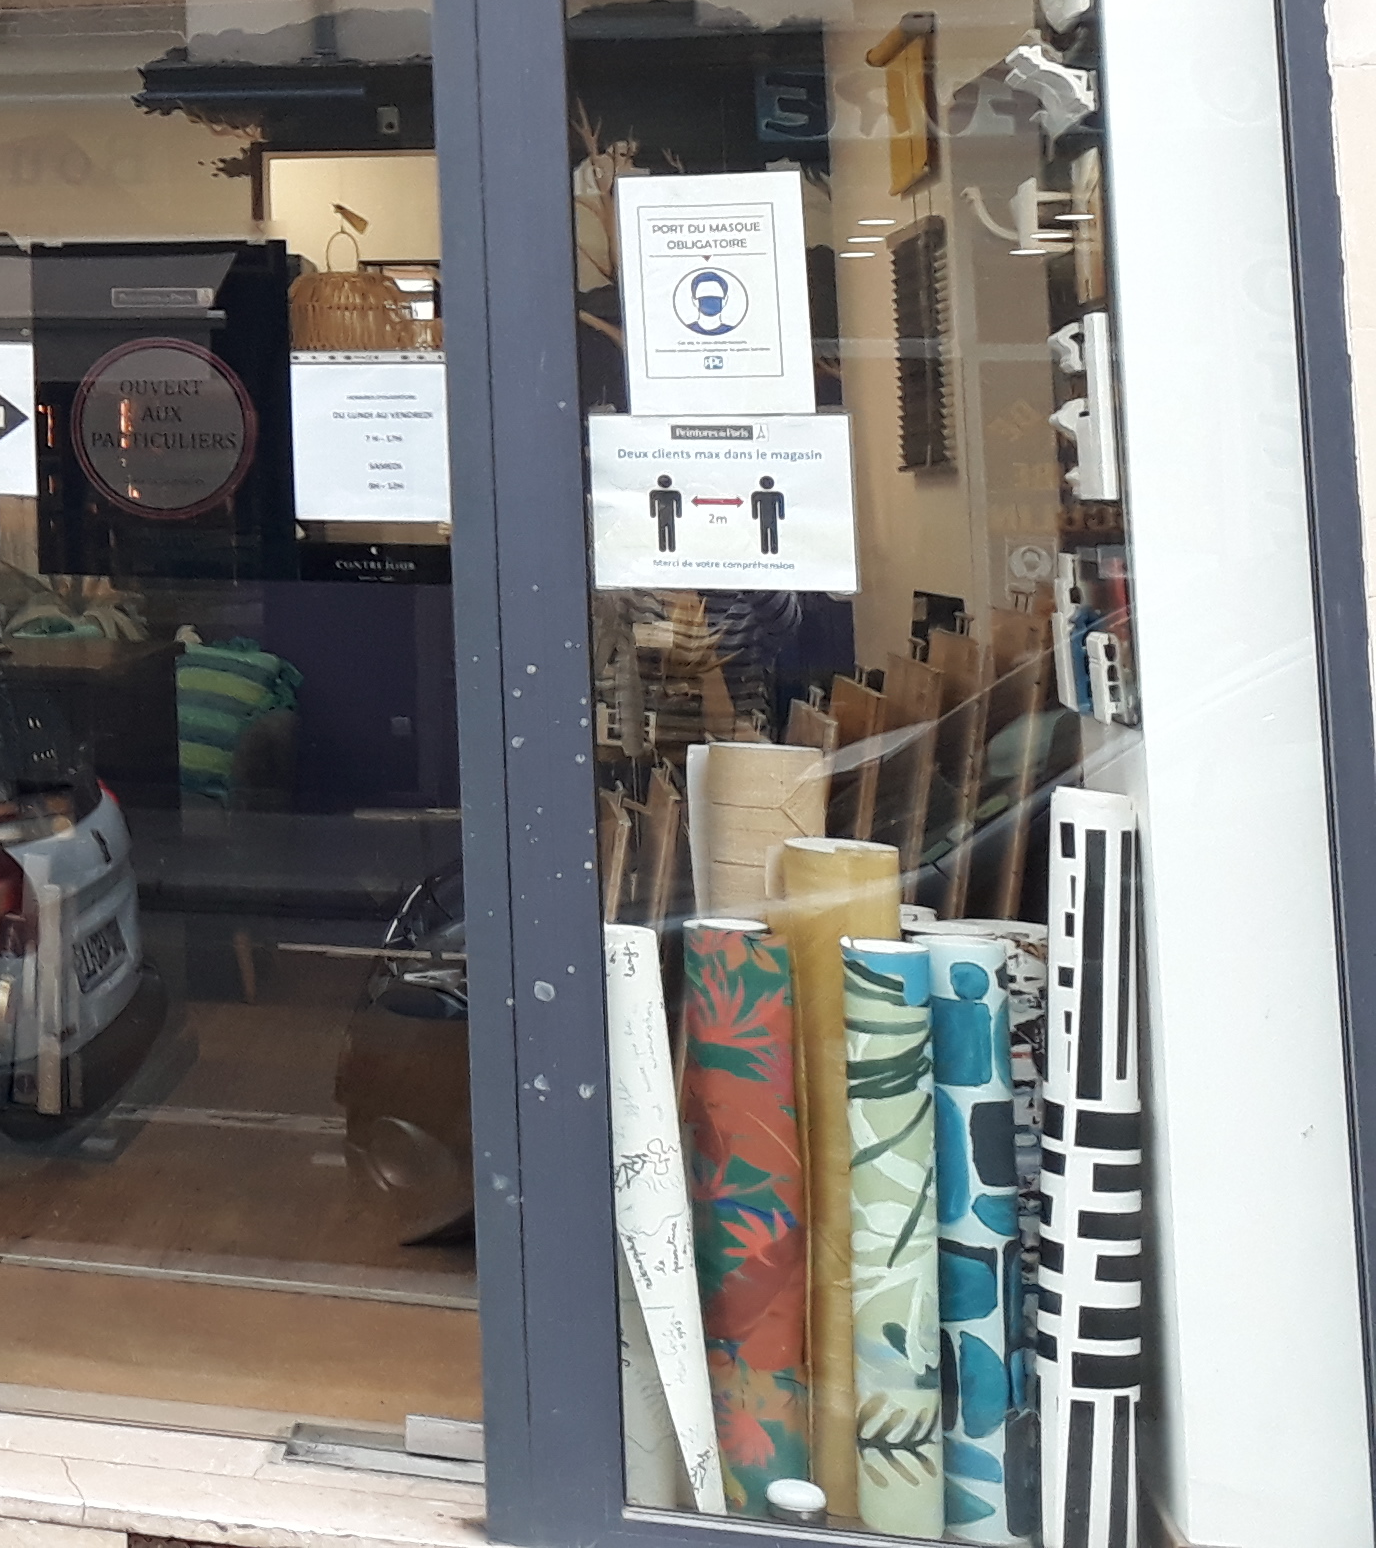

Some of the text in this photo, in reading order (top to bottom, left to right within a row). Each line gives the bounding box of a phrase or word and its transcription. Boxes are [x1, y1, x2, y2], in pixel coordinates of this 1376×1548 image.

[651, 221, 762, 235] PORT DU MASQUE
[666, 238, 748, 250] OBLIGATOIRE
[119, 378, 204, 397] OUVERT
[141, 405, 183, 423] AUX
[616, 447, 823, 463] Deux clients max dans le magasin
[708, 513, 728, 525] 2m
[681, 559, 694, 568] de
[696, 560, 721, 569] votre
